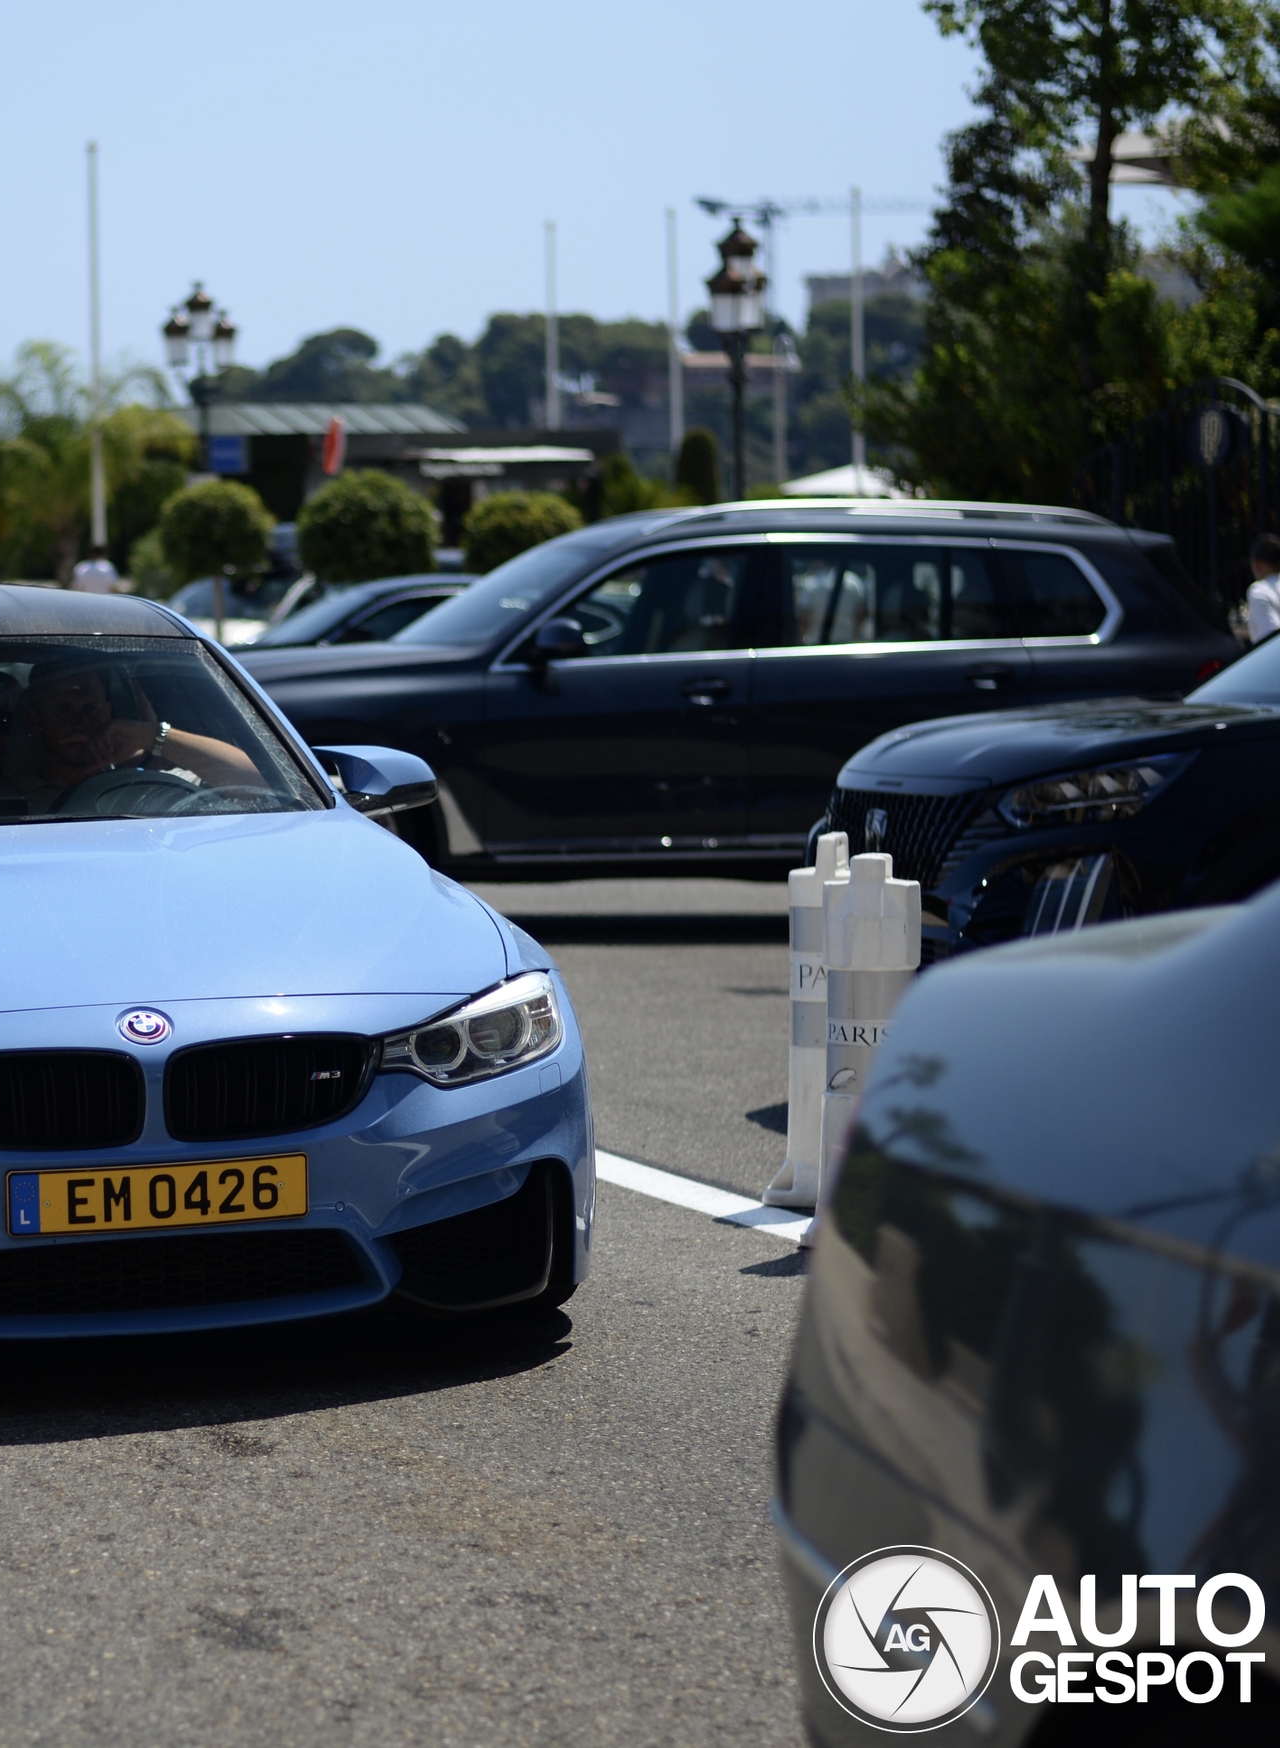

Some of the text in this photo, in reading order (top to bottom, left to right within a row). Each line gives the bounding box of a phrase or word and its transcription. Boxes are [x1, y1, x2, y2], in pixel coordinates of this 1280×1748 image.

[67, 1165, 279, 1225] EM 0426
[20, 1209, 31, 1225] L
